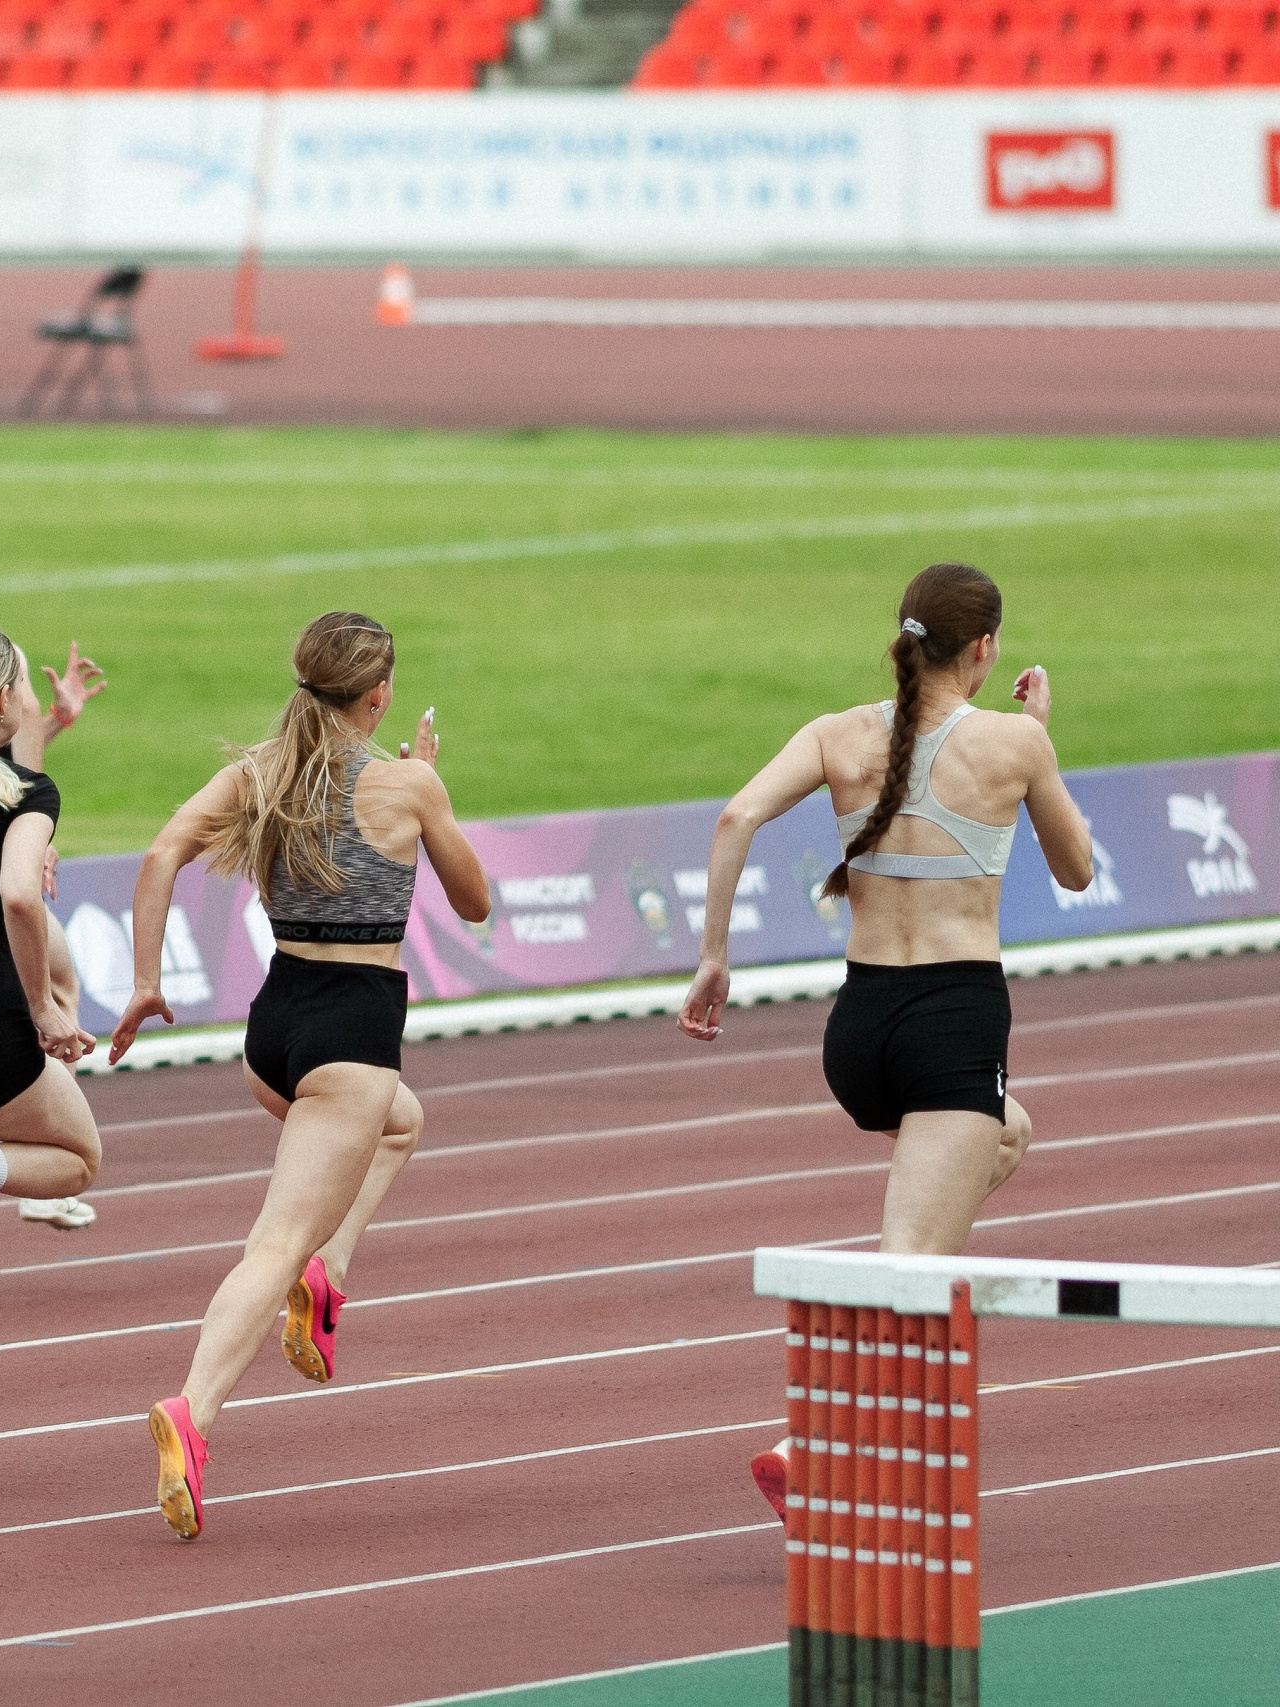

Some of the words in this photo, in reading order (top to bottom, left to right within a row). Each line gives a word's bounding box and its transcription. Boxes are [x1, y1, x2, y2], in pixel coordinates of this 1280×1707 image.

[887, 858, 927, 876] NIKE
[273, 924, 310, 938] PRO
[320, 926, 376, 940] NIKE
